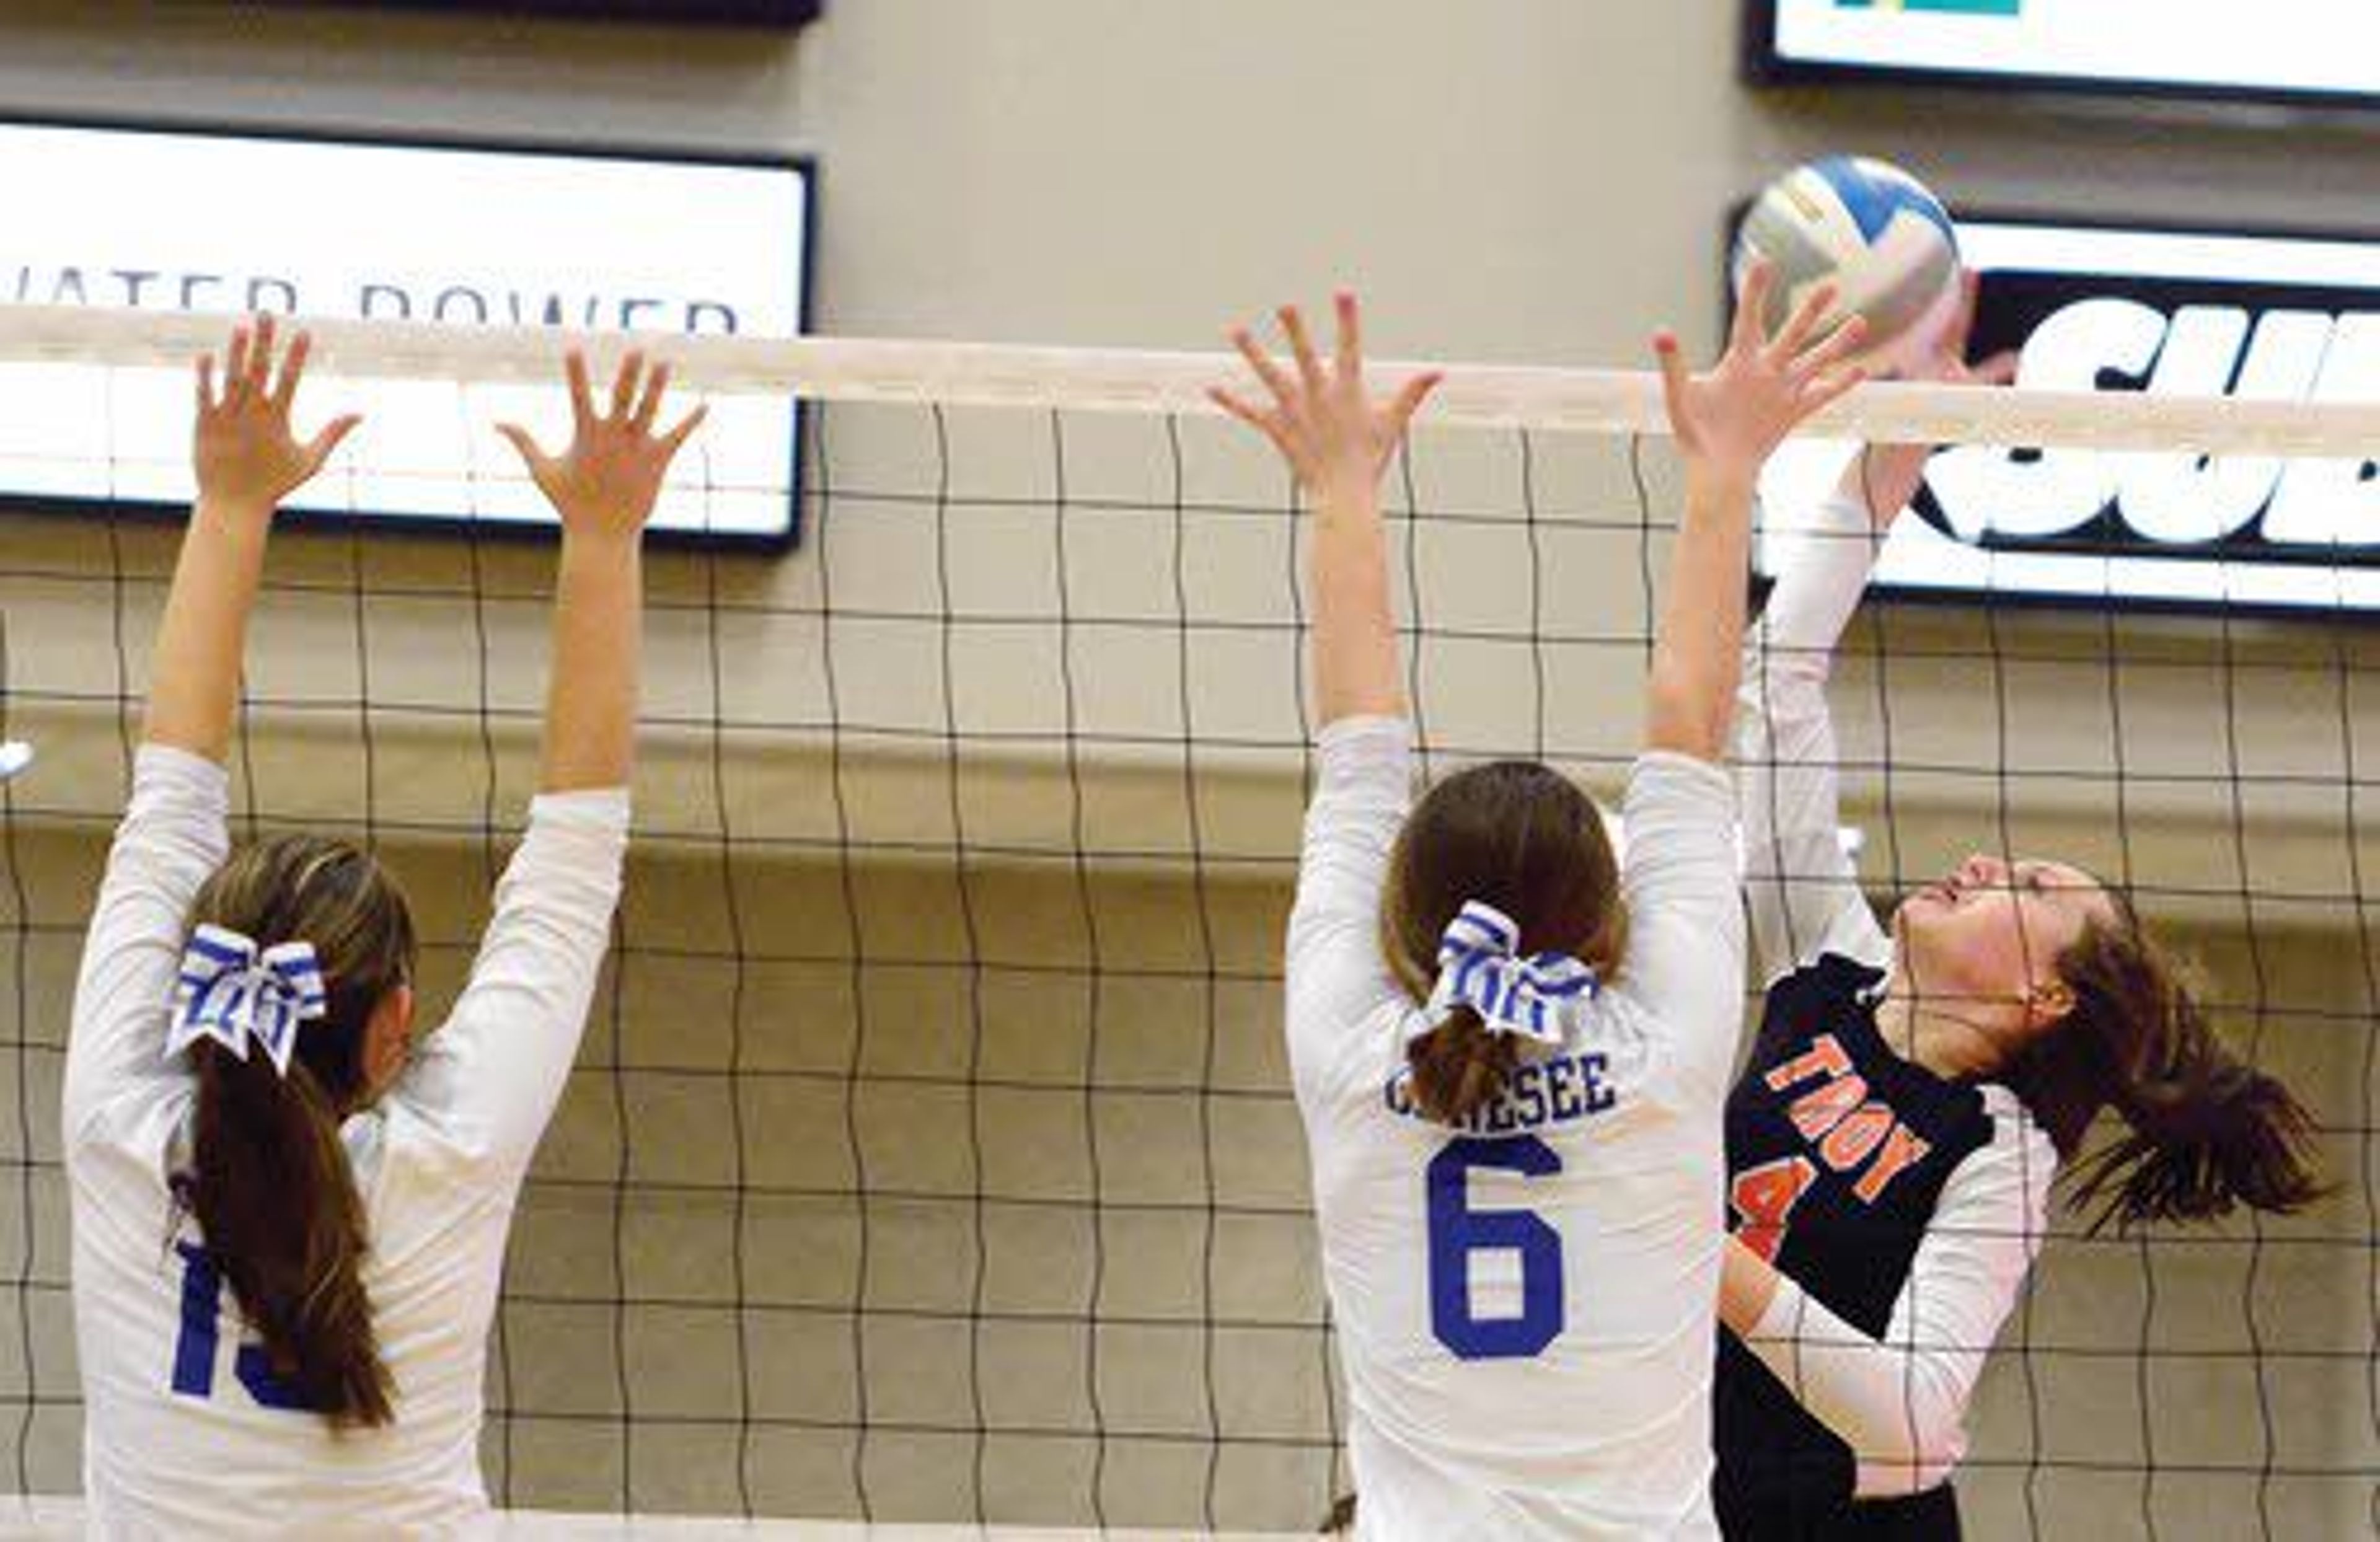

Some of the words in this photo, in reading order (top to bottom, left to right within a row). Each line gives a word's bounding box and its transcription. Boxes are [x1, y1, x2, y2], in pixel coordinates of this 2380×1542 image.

[1765, 1033, 1931, 1204] TROY
[1427, 1135, 1564, 1360] 6
[1732, 1156, 1819, 1264] 4
